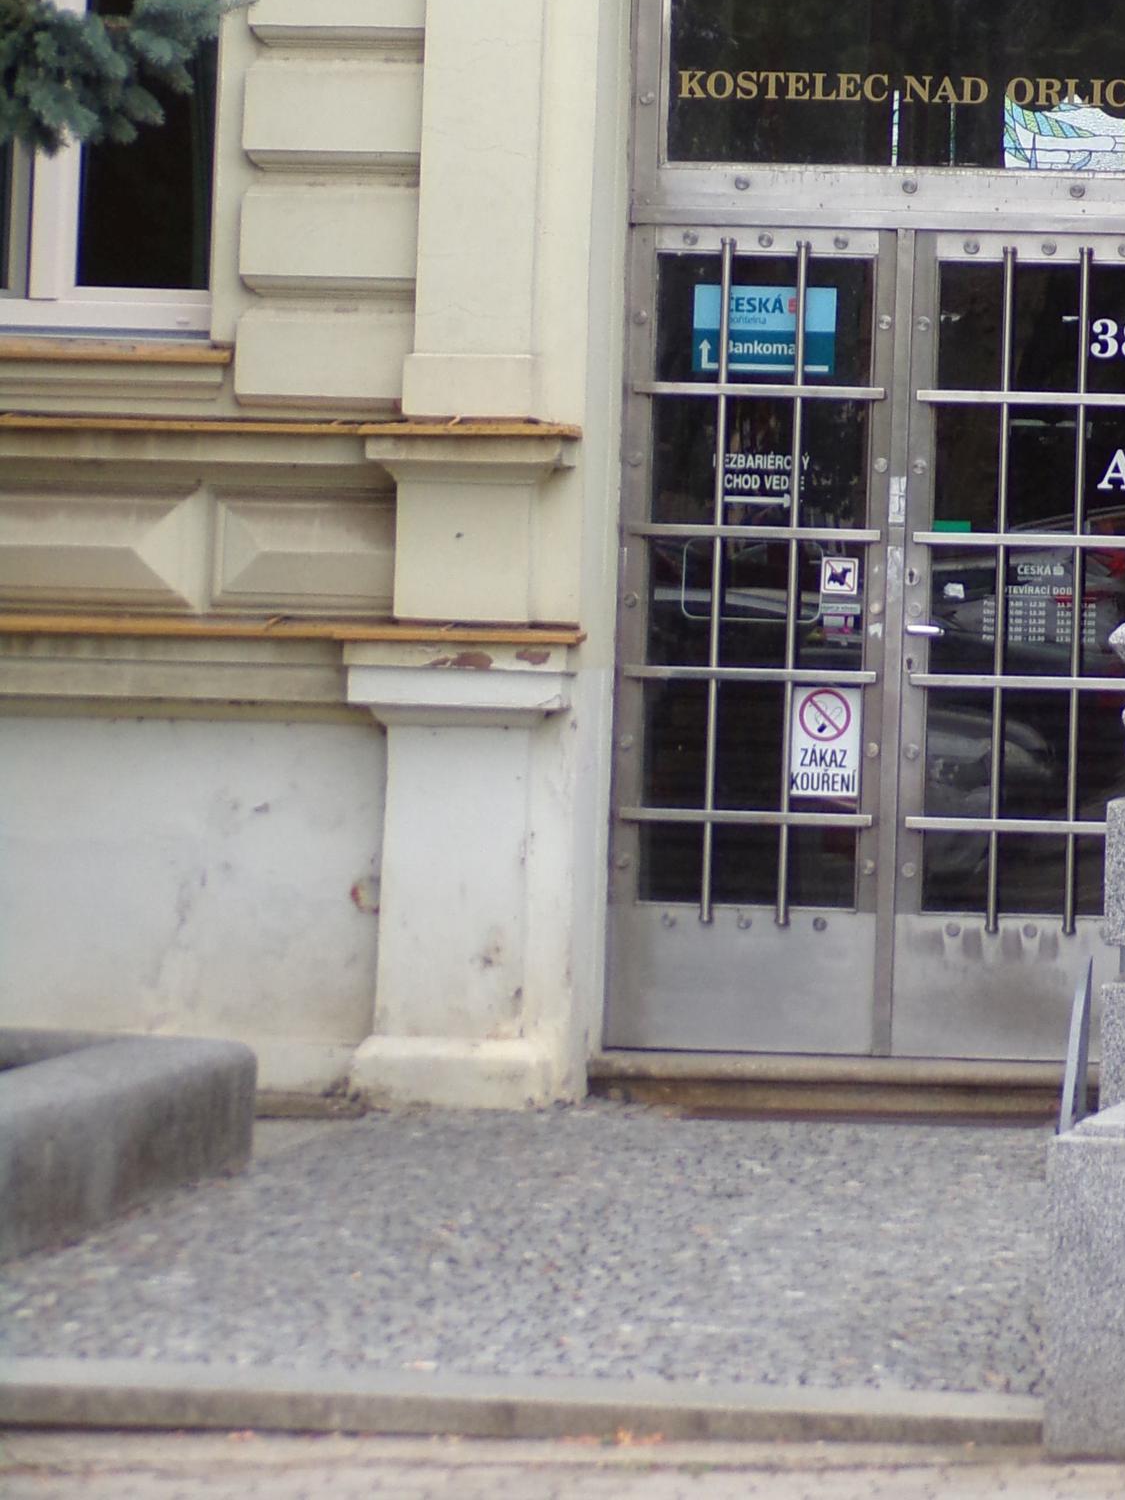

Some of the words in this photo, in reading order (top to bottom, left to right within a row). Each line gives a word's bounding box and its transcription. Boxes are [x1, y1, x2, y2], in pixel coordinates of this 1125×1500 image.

[678, 70, 890, 103] KOSTELEC
[904, 74, 989, 105] NAD
[800, 744, 848, 769] ZÁKAZ
[790, 768, 857, 793] KOUŘENÍ
